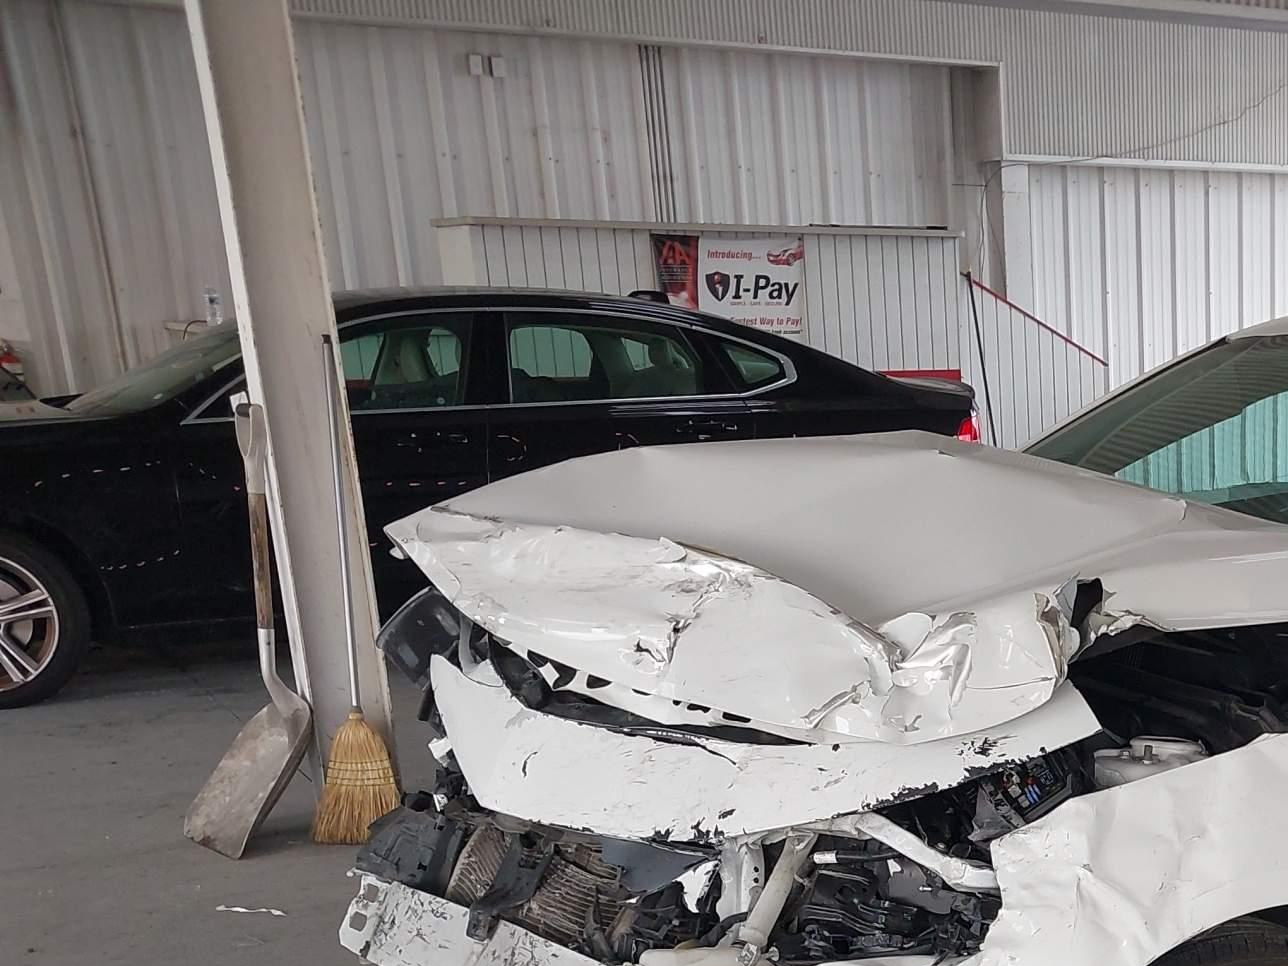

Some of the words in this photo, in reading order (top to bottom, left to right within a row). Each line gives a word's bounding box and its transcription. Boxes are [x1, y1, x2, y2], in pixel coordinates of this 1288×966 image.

[732, 274, 799, 306] I-Pay
[759, 316, 774, 327] Way
[776, 317, 784, 326] to
[786, 316, 803, 327] Pay!
